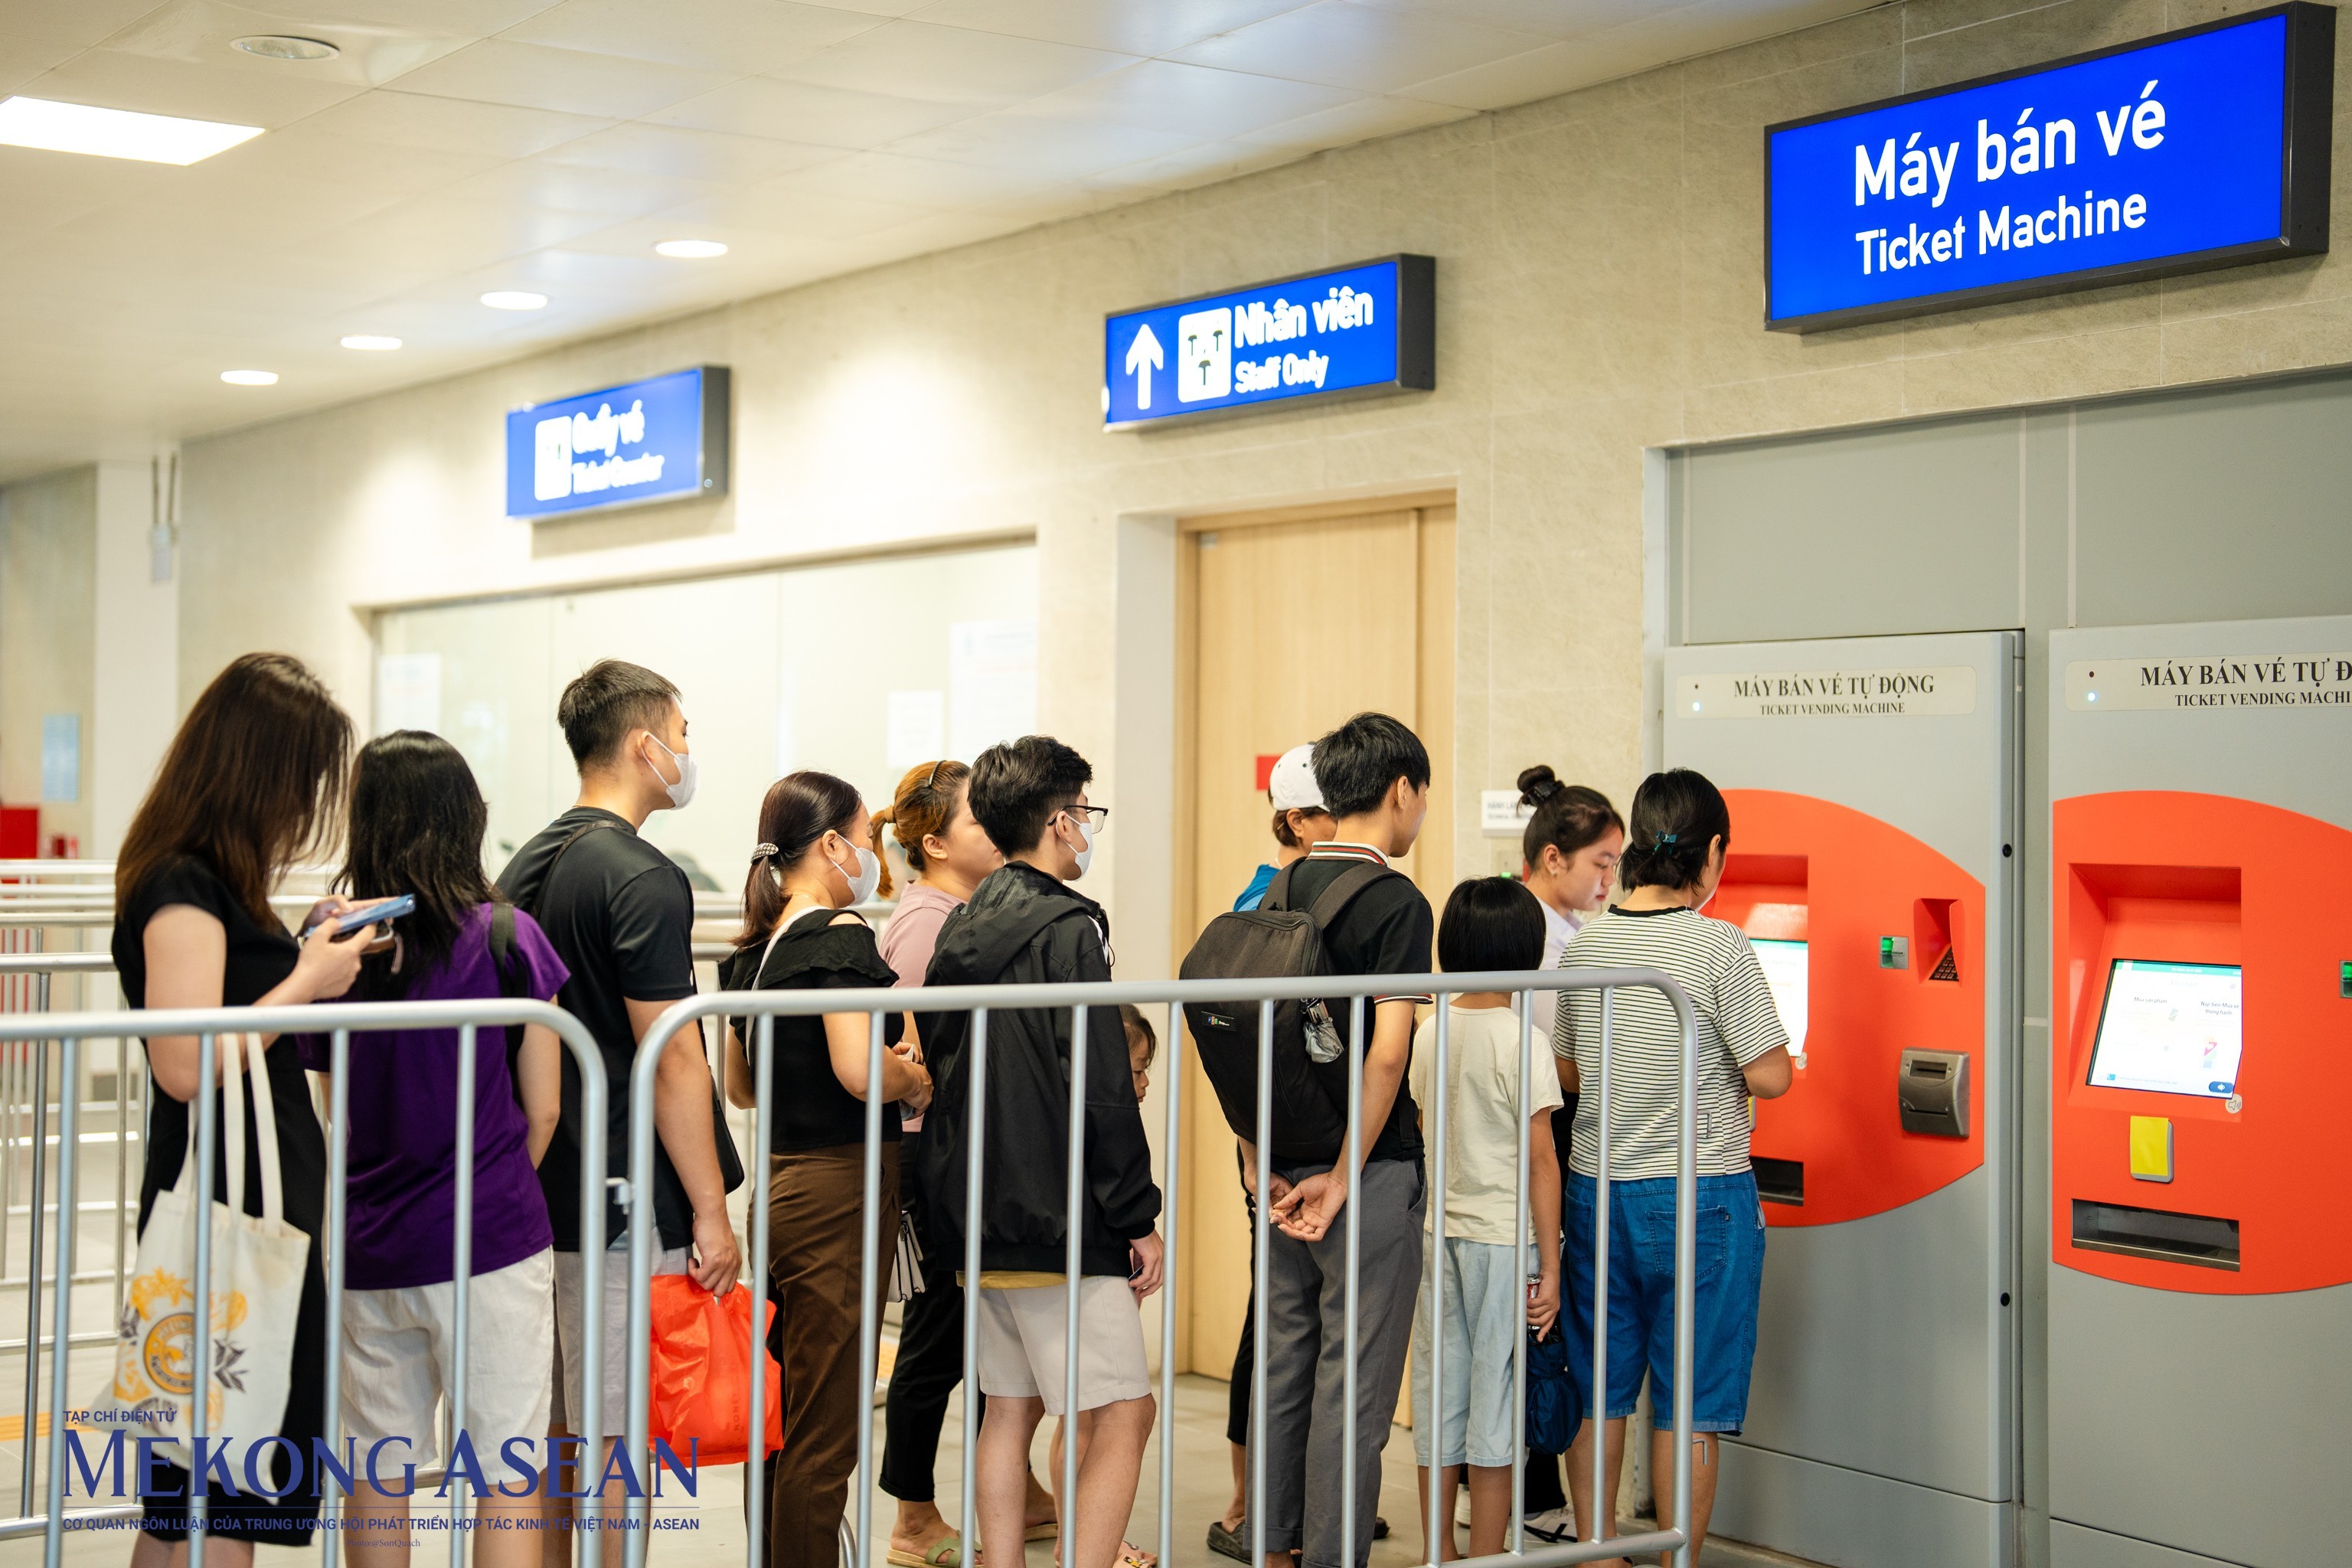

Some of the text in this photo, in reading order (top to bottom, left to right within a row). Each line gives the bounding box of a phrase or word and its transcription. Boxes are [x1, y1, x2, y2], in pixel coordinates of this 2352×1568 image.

[1854, 80, 2167, 209] Máy bán vé
[1855, 191, 2148, 276] Ticket Machine
[1234, 286, 1374, 348] Nhân viên
[1234, 349, 1329, 394] Staff Only
[1734, 672, 1935, 699] MÁY BÁN VÉ TỰ ĐỘNG
[2141, 660, 2194, 686] MÁY
[2200, 658, 2247, 684] BÁN
[2254, 657, 2287, 683] VÉ
[2292, 657, 2331, 688] TỰ
[1760, 702, 1905, 715] TICKET VENDING MACHINE
[2175, 694, 2227, 707] TICKET
[2230, 692, 2295, 706] VENDING
